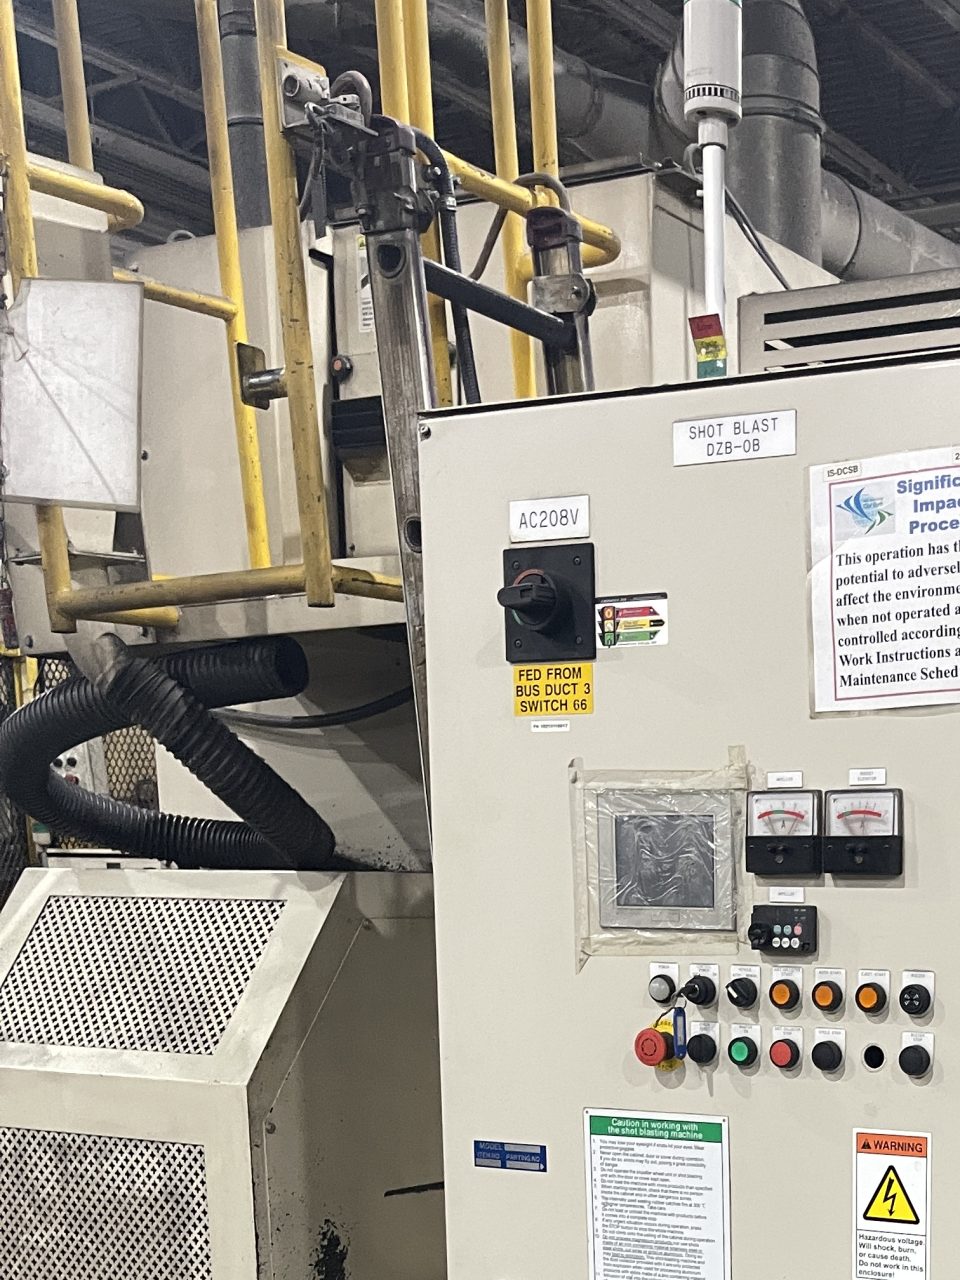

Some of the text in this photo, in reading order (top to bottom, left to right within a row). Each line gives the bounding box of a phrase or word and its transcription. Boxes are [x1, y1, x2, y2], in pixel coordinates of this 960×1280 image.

[689, 417, 778, 440] SHOT BLAST
[827, 465, 859, 477] IS-DCSB
[519, 508, 579, 529] AC208V
[836, 552, 862, 566] This
[865, 545, 924, 565] operation
[928, 543, 950, 555] has
[836, 568, 888, 590] potential
[892, 568, 904, 580] to
[836, 592, 869, 607] affect
[873, 590, 892, 603] the
[837, 613, 868, 626] when
[872, 611, 891, 624] not
[895, 604, 950, 623] operated
[838, 630, 898, 647] controlled
[839, 653, 873, 666] Work
[876, 647, 950, 664] Instructions
[518, 667, 582, 681] FED FROM
[840, 671, 917, 687] Maintenance
[516, 683, 590, 697] BUS DUCT 3
[520, 699, 587, 712] SWITCH 66
[611, 1118, 699, 1131] Caution in working with
[607, 1126, 703, 1139] the shot blasting machine
[873, 1140, 923, 1153] WARNING
[858, 1234, 925, 1246] Hazardous voltage.
[873, 1244, 896, 1252] shock,
[898, 1246, 917, 1254] burn,
[890, 1253, 911, 1262] death.
[858, 1269, 895, 1278] enclosure!
[883, 1262, 900, 1270] work
[910, 1264, 924, 1272] this
